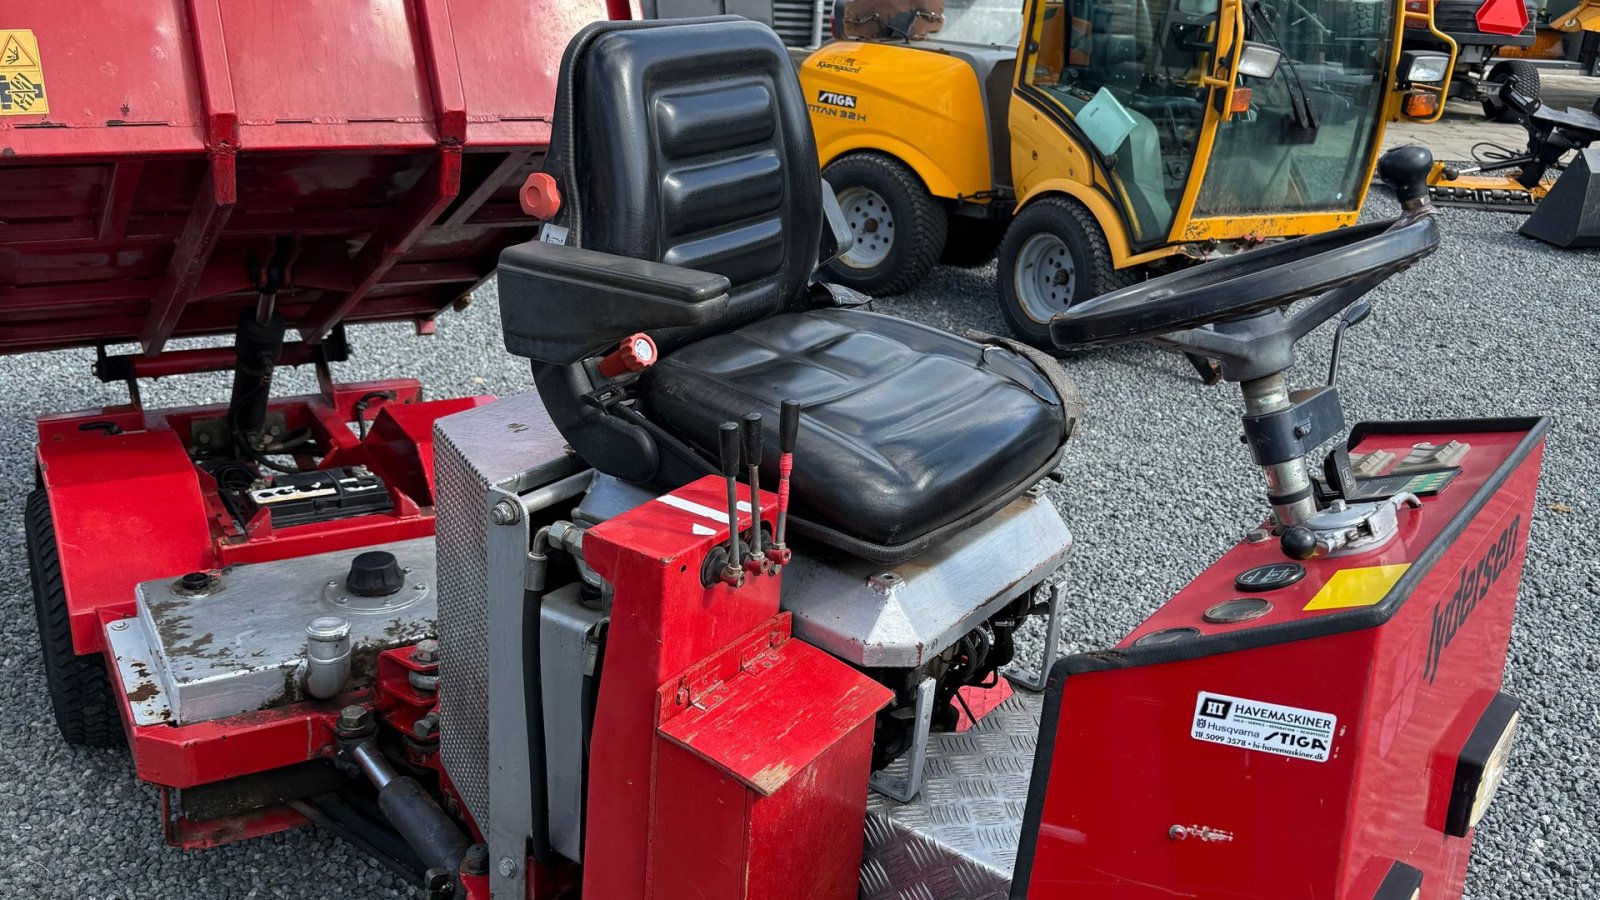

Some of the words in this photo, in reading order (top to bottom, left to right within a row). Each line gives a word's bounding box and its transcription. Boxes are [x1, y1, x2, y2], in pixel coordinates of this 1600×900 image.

[819, 93, 854, 106] STIGA
[808, 104, 837, 116] TITAN
[1235, 704, 1331, 729] HAVEMASKINER
[1207, 722, 1260, 739] Husqvarna
[1227, 736, 1246, 747] 3578
[1252, 741, 1324, 760] hi-havemaskiner.dk
[1264, 732, 1326, 751] STIGA
